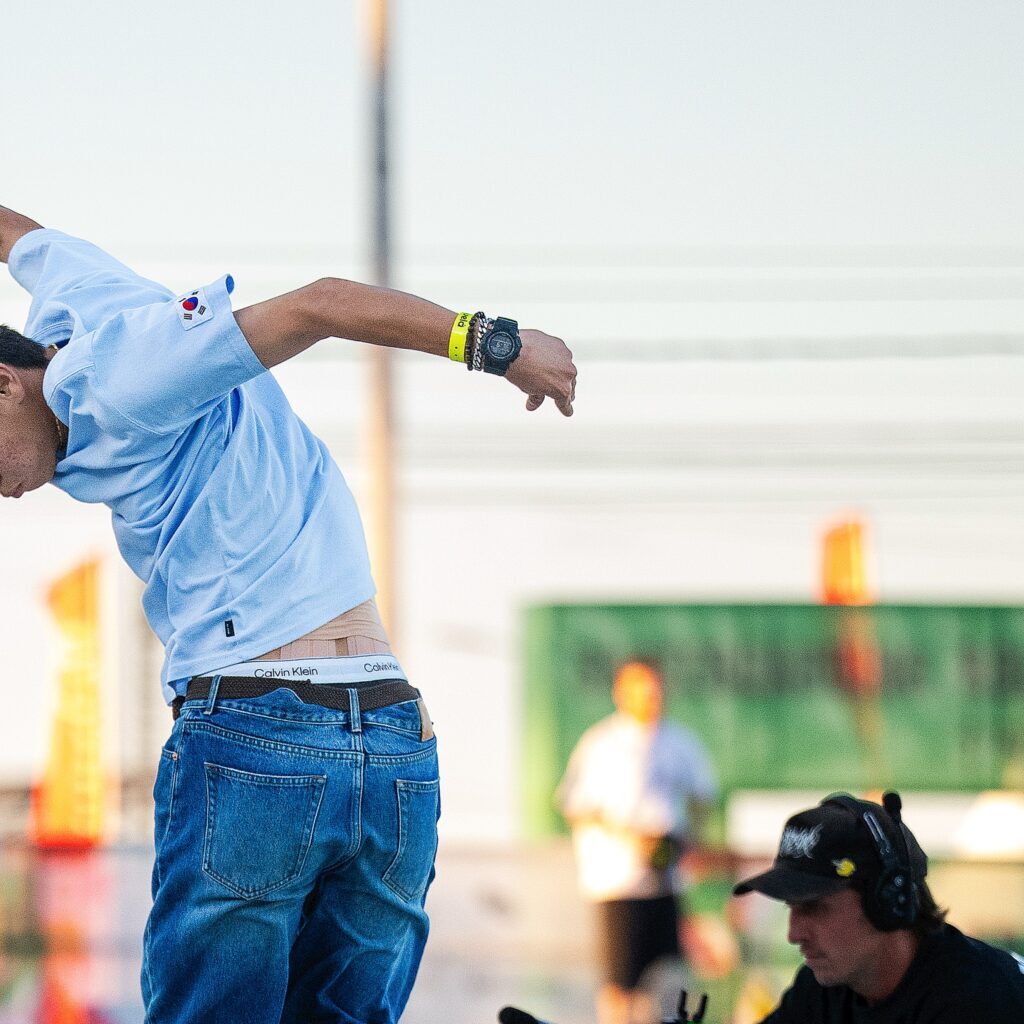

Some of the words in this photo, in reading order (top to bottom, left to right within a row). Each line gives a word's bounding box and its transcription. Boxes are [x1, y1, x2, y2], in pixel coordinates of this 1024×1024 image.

[254, 667, 291, 678] Calvin
[292, 666, 318, 677] Klein
[363, 662, 390, 673] Calvin
